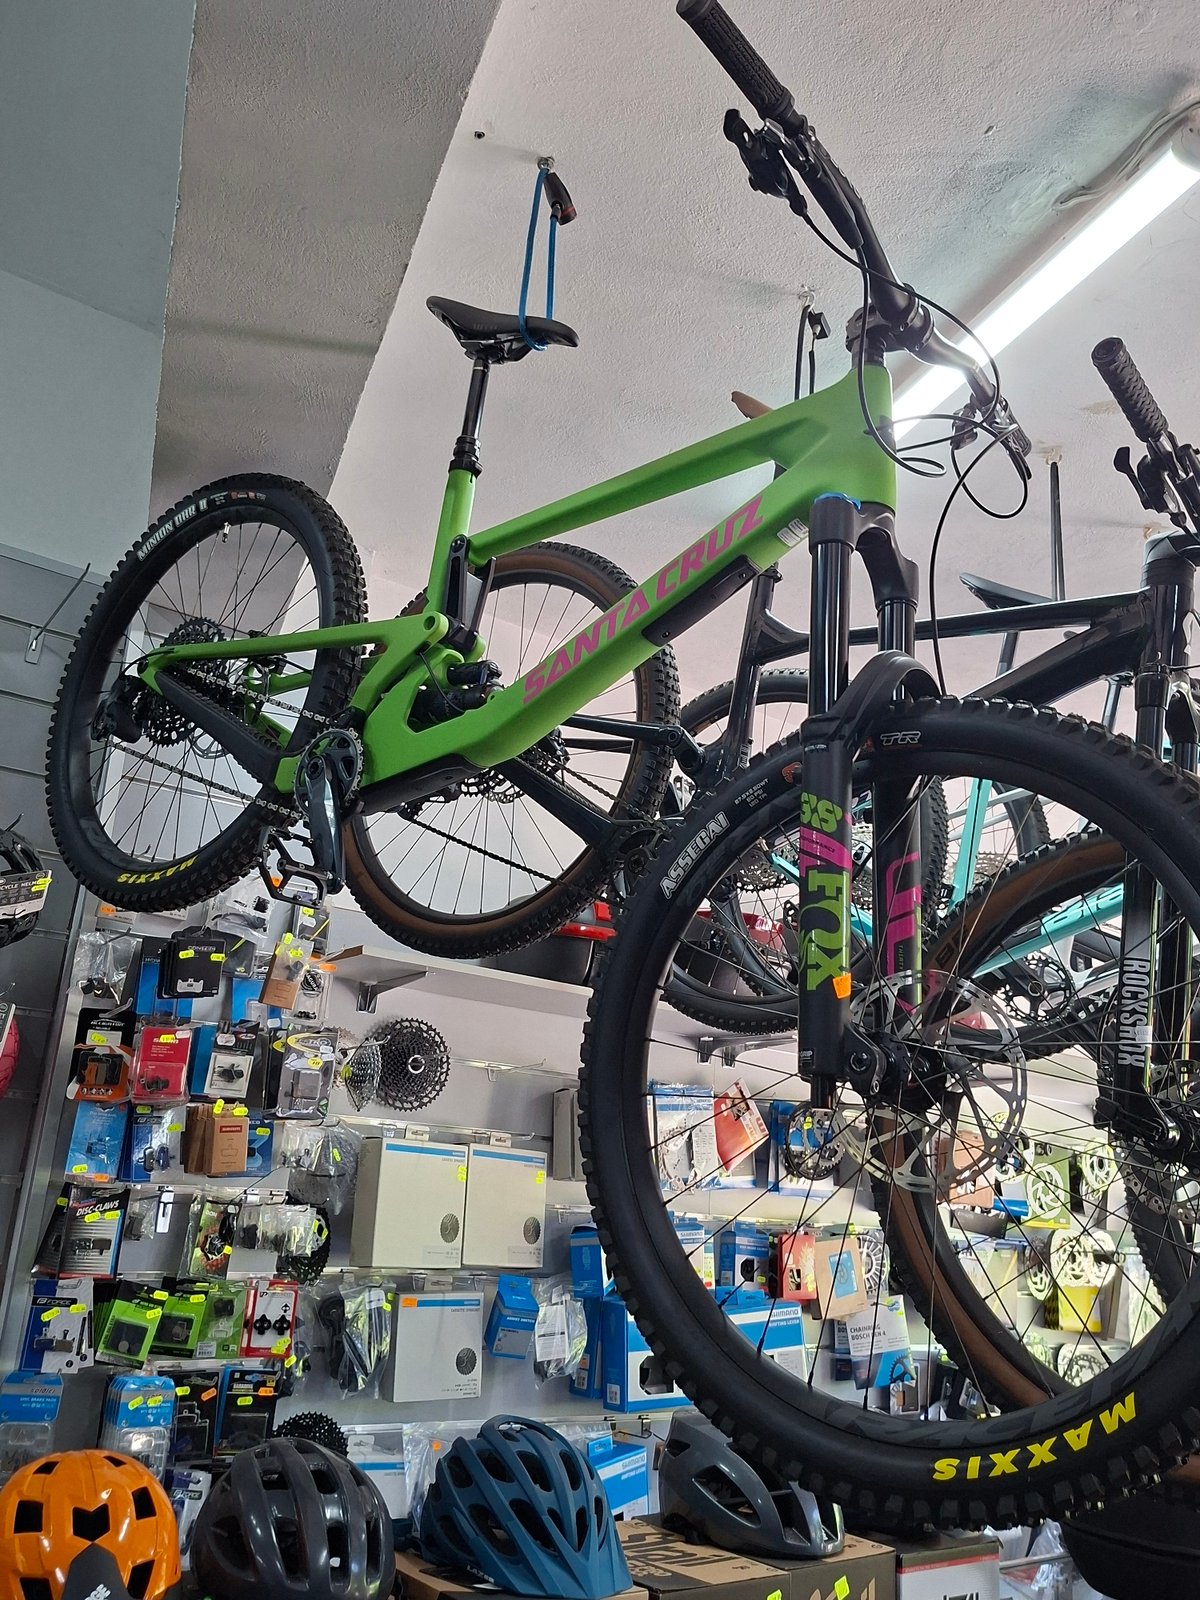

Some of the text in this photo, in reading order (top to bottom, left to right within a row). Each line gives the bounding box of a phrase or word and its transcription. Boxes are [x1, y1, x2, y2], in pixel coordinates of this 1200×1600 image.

[136, 519, 175, 562] MINION
[174, 503, 197, 527] DHR
[522, 588, 651, 705] SANTA
[655, 495, 765, 602] CRUZ
[880, 731, 921, 746] TR
[117, 854, 199, 885] MAXXIS
[659, 811, 730, 900] ASSEGAI
[801, 870, 849, 991] FOX
[1117, 957, 1151, 1068] ROCKSHOX
[76, 1199, 119, 1217] DISC-CLAWS
[932, 1391, 1136, 1481] MAXXIS
